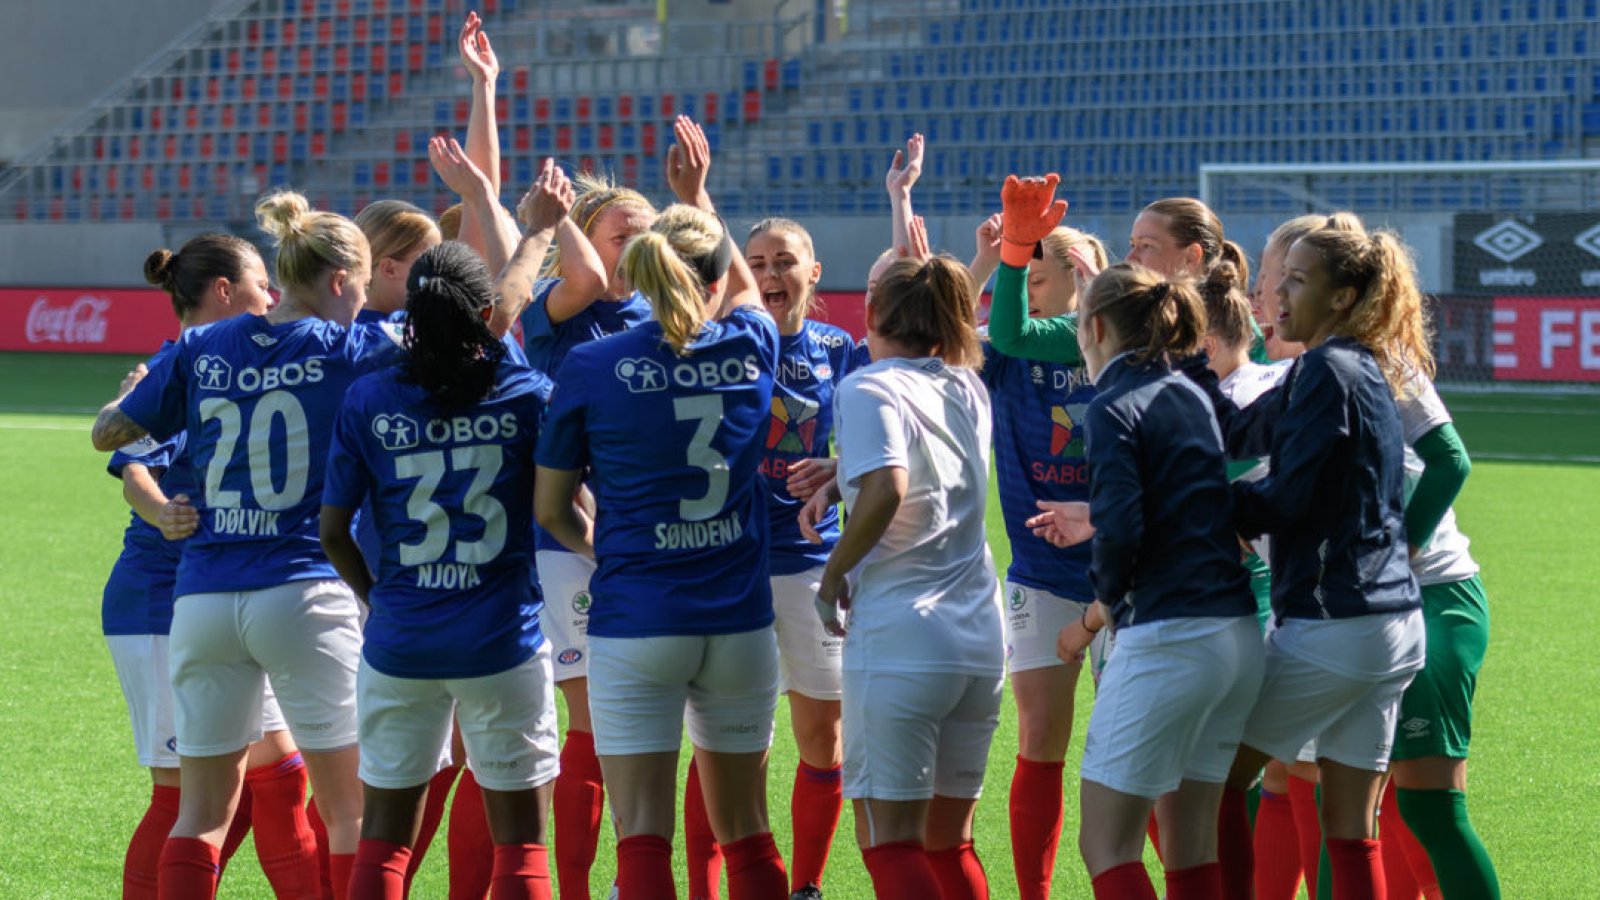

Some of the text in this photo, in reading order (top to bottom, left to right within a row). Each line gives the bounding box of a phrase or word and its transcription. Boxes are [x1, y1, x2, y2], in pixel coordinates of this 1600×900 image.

[237, 359, 324, 391] OBOS
[673, 355, 760, 387] OBOS
[425, 413, 518, 443] OBOS
[199, 390, 310, 511] 20
[673, 394, 730, 521] 3
[395, 445, 508, 566] 33
[214, 508, 281, 536] DØLVIK
[416, 563, 480, 590] NJOYA
